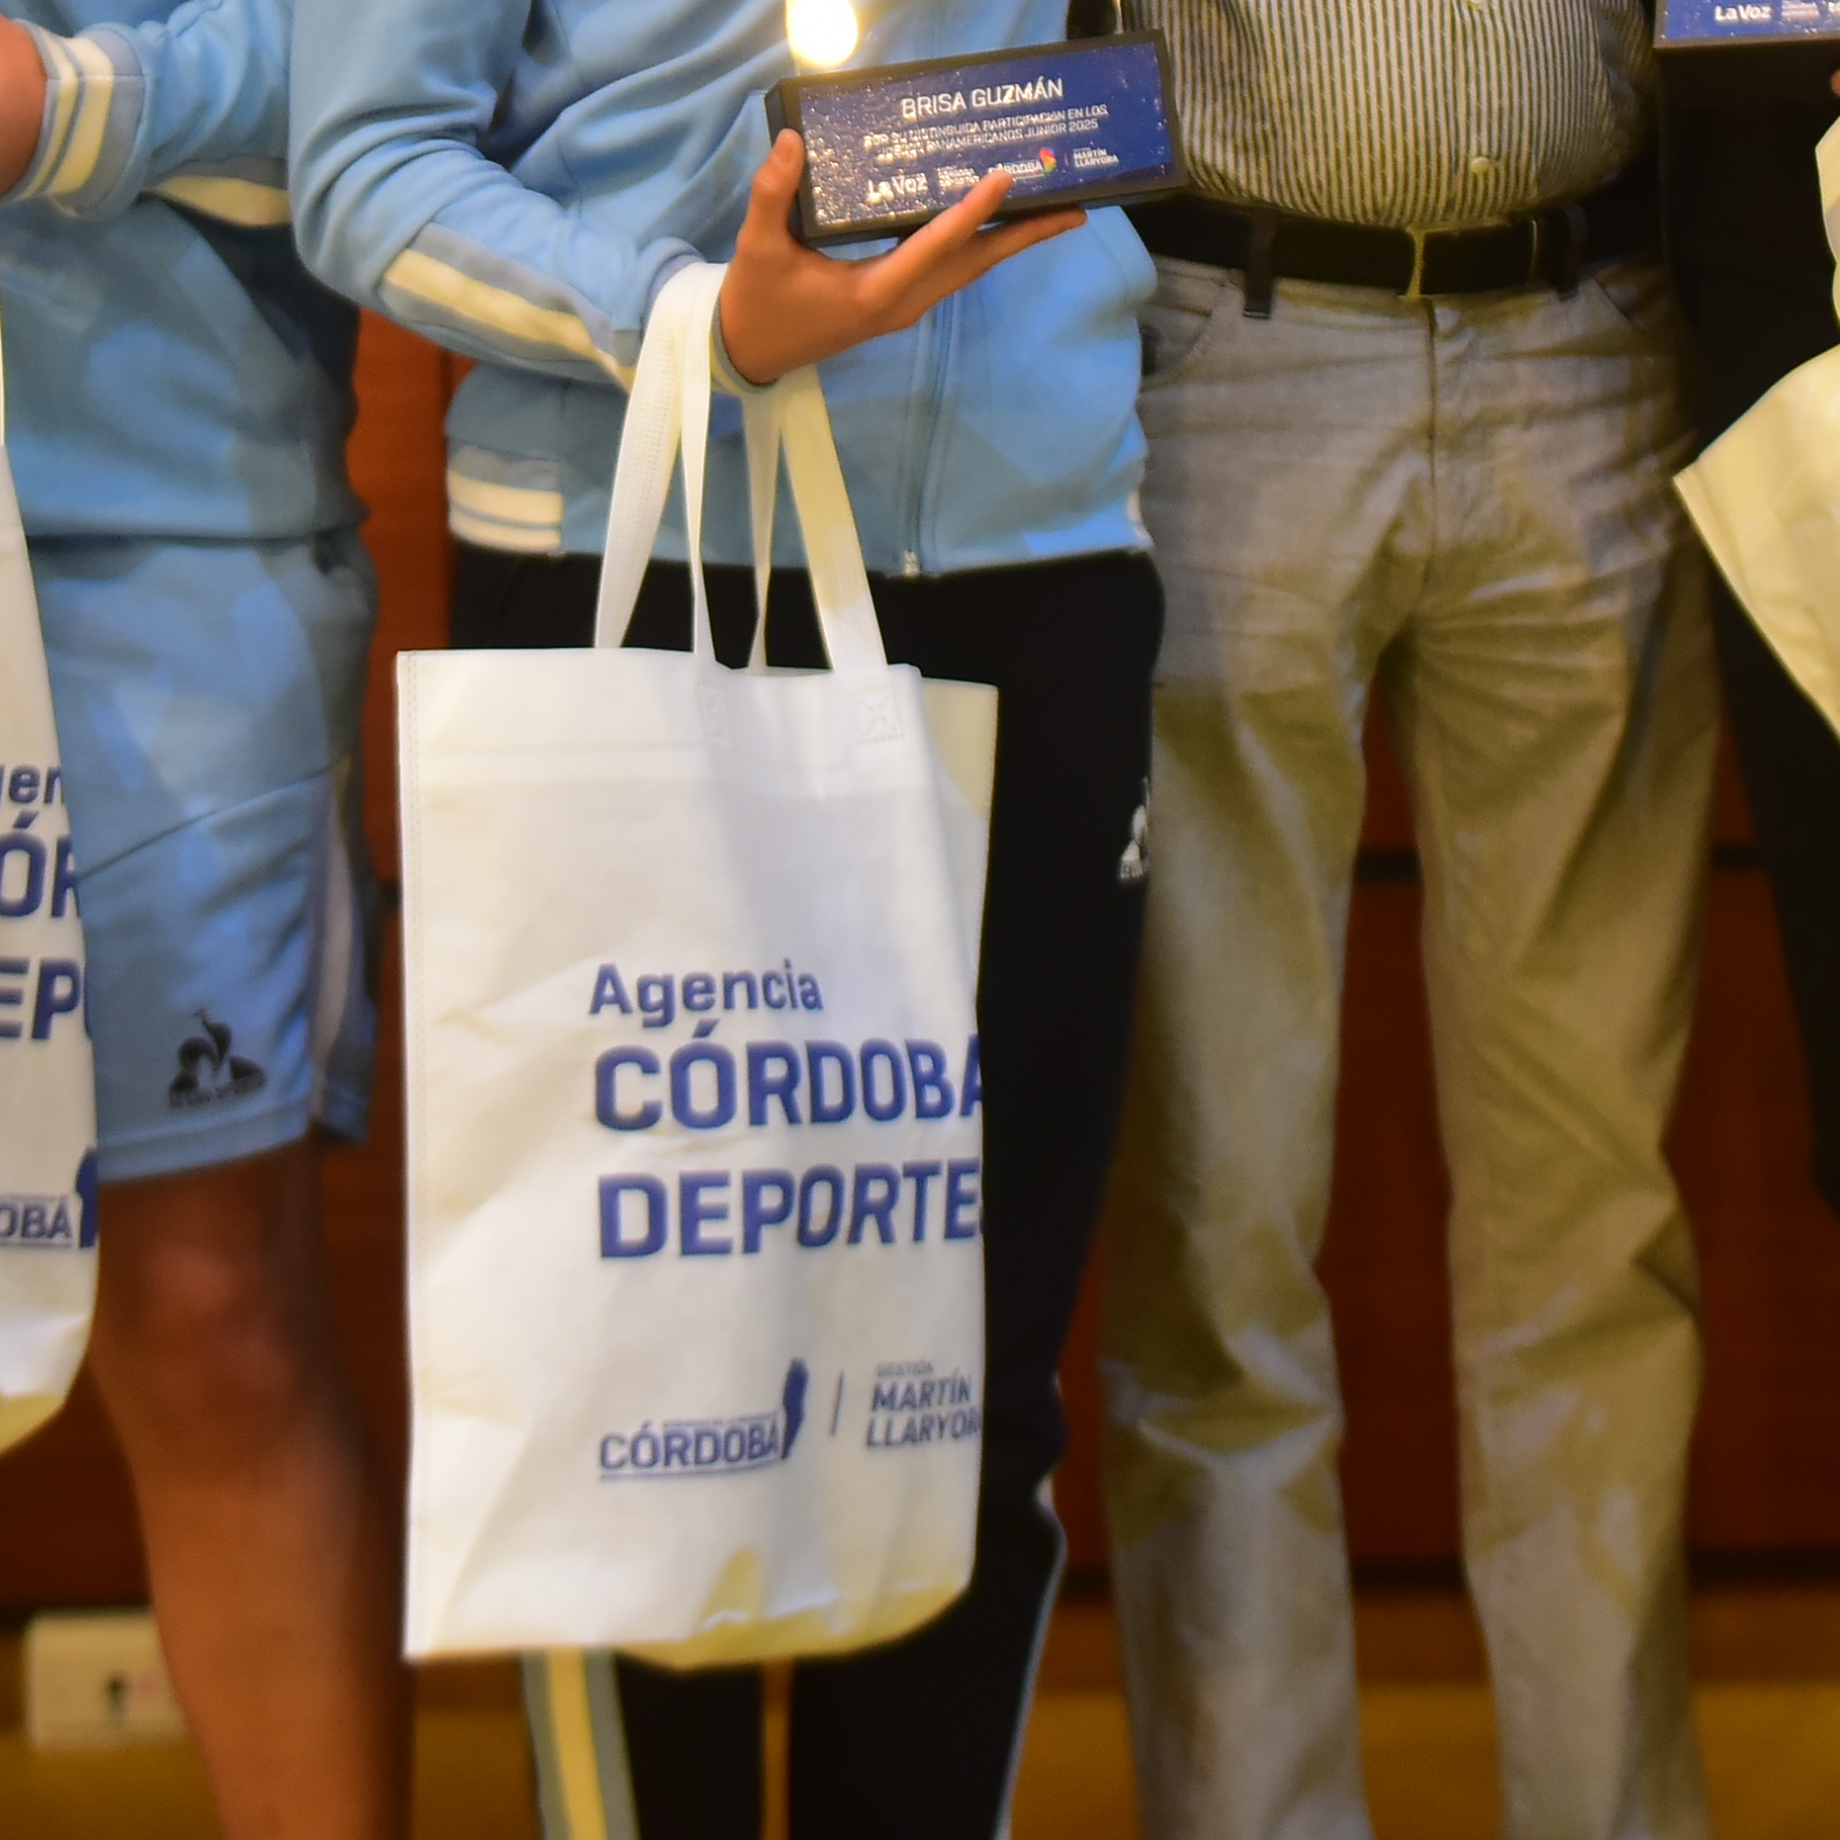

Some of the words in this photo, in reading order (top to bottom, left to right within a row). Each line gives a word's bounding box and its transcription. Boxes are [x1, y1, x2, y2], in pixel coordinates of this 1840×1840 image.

[901, 91, 966, 119] BRISA
[972, 76, 1063, 108] GUZMÁN
[1068, 107, 1084, 119] EN
[1085, 104, 1109, 117] LOS
[1025, 123, 1067, 138] JUNIOR
[1069, 118, 1099, 131] 2025
[589, 958, 824, 1028] Agencia
[598, 1156, 984, 1259] DEPORTE
[871, 1368, 971, 1412] MARTÍN
[599, 1418, 779, 1470] CÓRDOBA
[866, 1407, 982, 1448] LLARYOR
